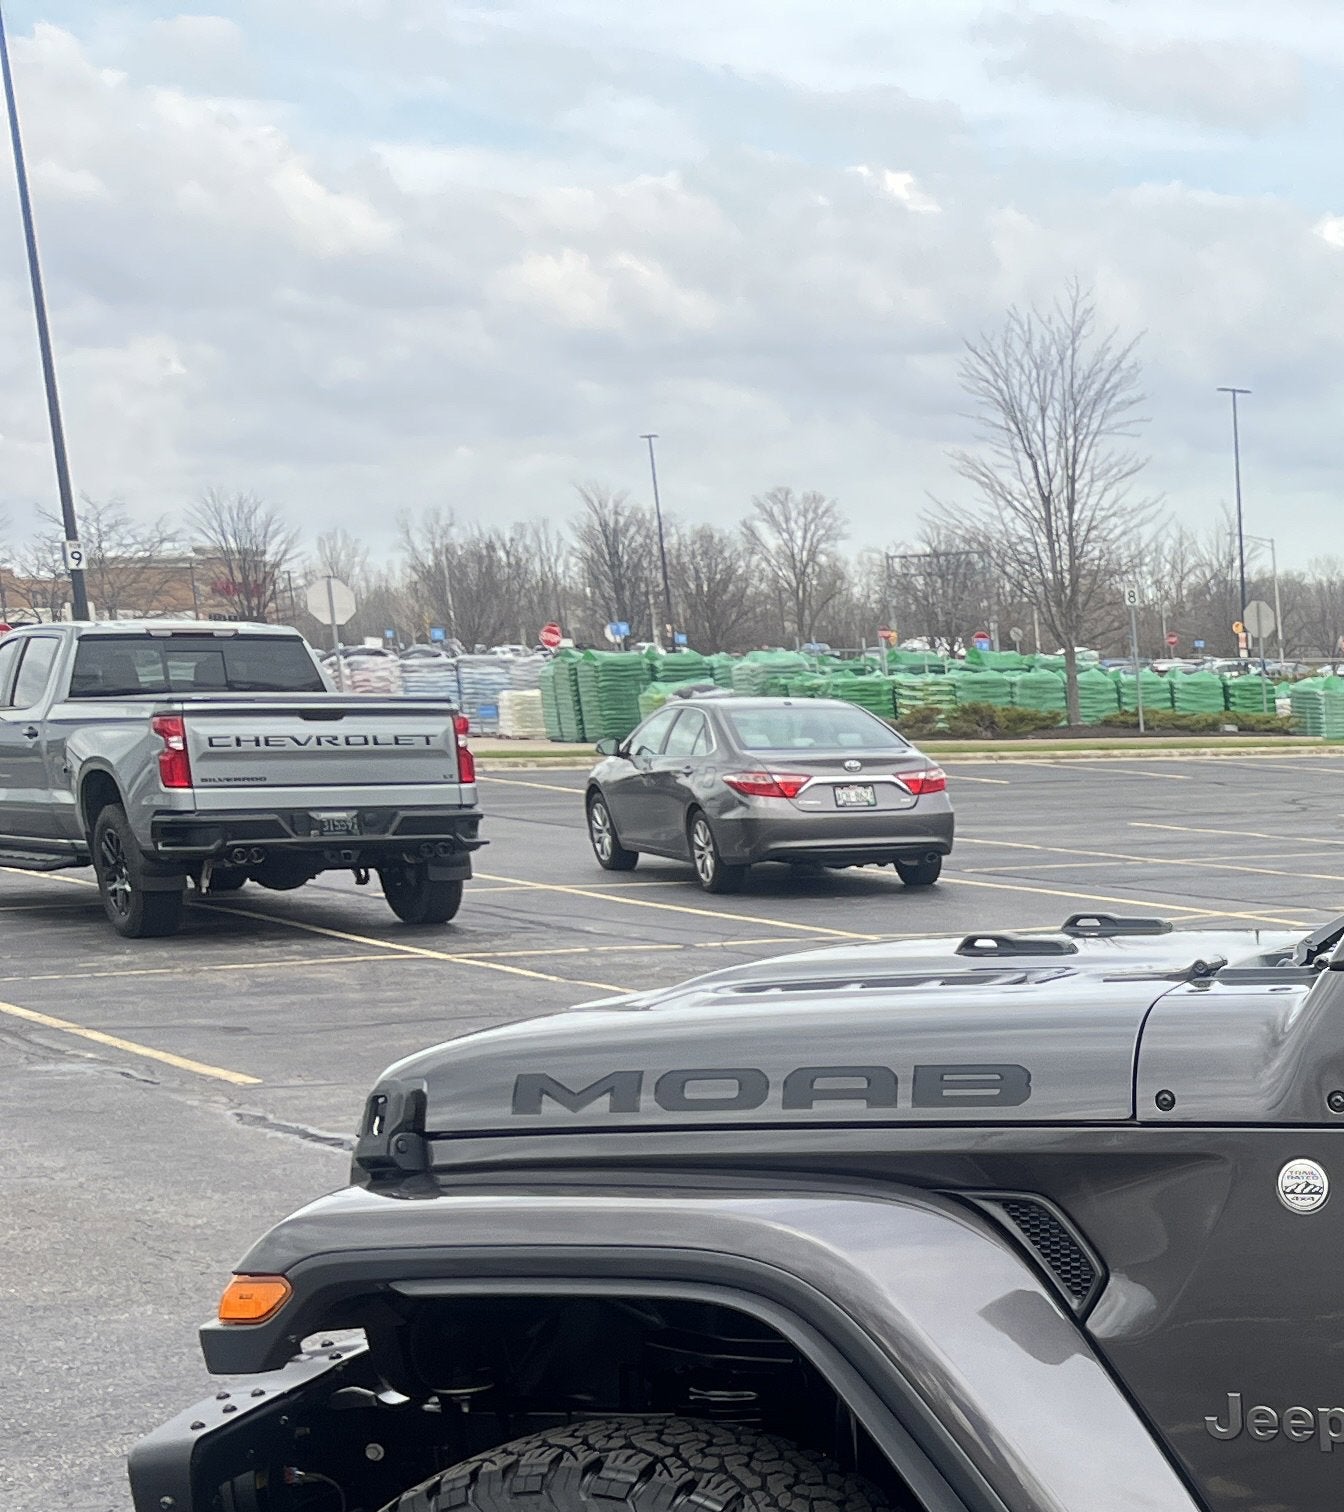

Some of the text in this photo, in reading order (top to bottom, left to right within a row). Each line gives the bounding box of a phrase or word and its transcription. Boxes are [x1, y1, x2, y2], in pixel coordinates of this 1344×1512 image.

[71, 551, 82, 566] 9
[1127, 589, 1137, 605] 8
[207, 734, 439, 748] CHEVROLET
[511, 1064, 1032, 1115] MOAB
